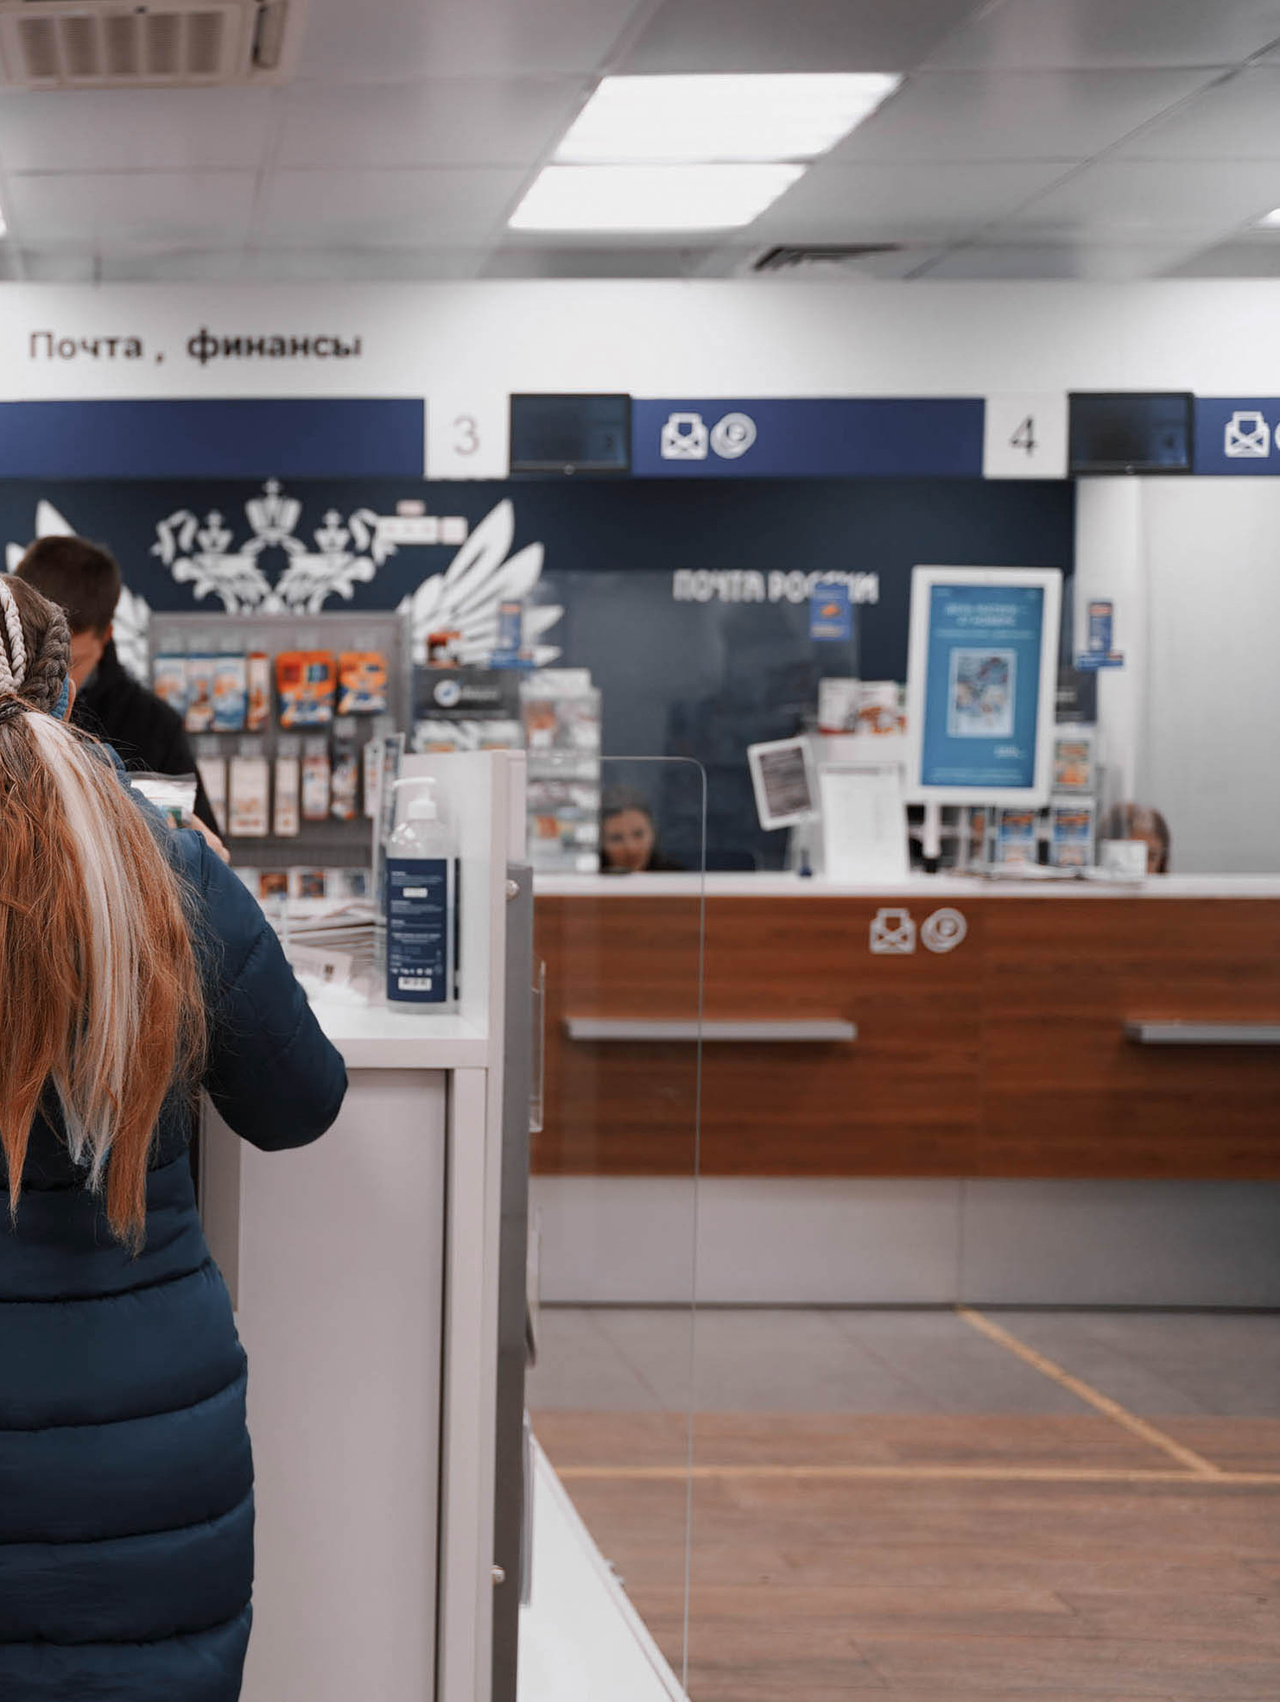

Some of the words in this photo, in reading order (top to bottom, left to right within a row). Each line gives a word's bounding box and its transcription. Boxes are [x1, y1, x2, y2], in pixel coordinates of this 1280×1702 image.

[187, 327, 361, 366] финансы
[453, 414, 480, 457] 3
[1008, 416, 1039, 458] 4
[673, 569, 765, 602] ПОЧТА
